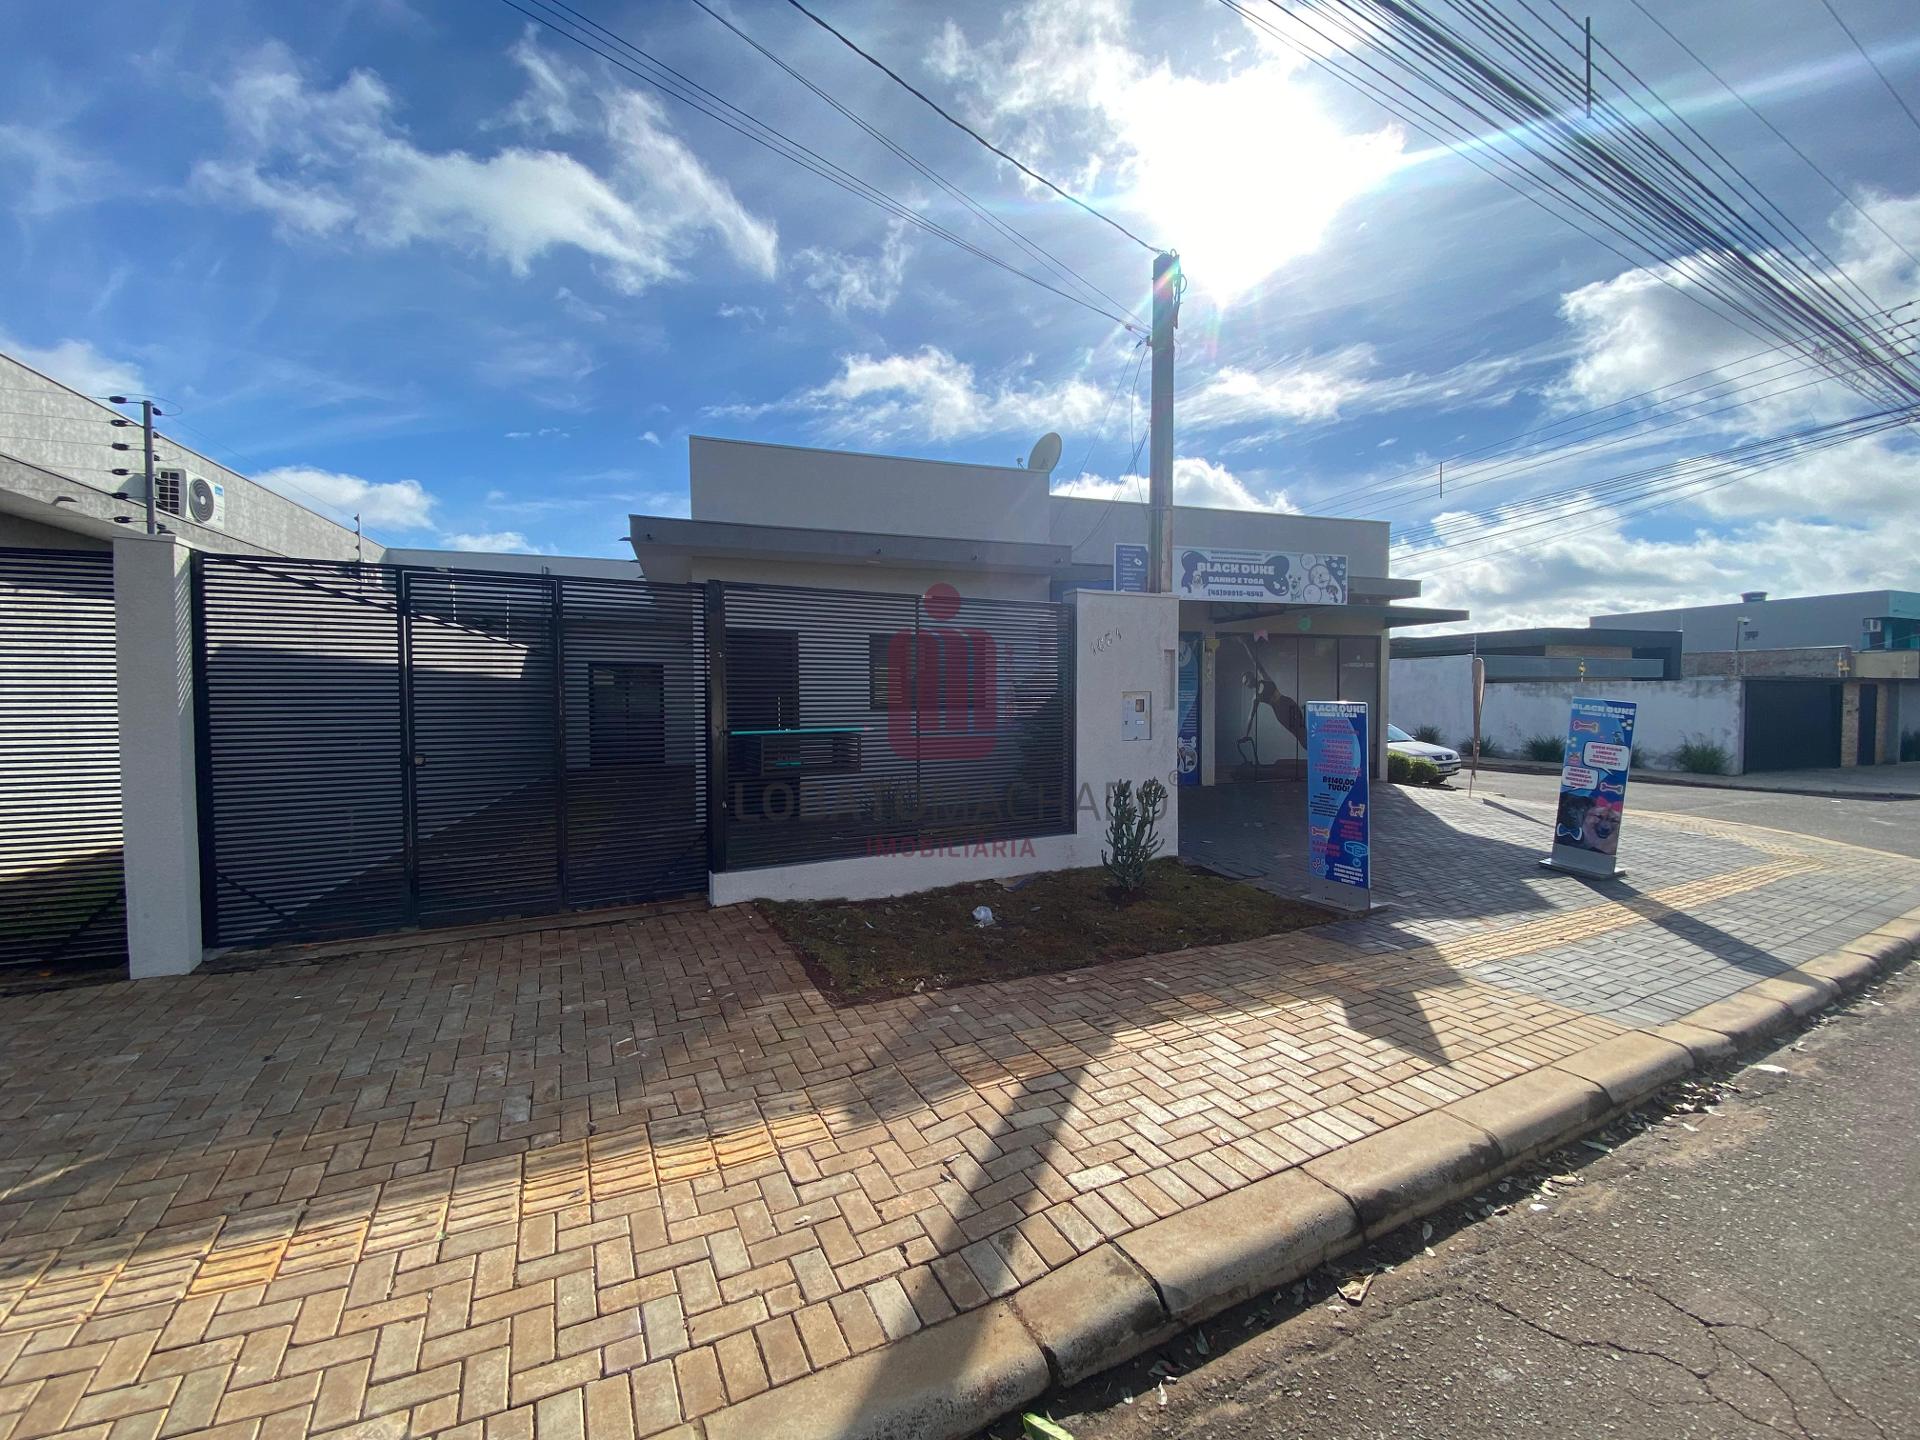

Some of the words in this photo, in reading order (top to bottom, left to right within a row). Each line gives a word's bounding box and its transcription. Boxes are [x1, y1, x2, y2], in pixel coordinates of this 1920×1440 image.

[1196, 562, 1239, 573] BLACK
[1241, 564, 1275, 576] DUKE
[1208, 576, 1236, 584] BANHO
[1308, 704, 1338, 713] BLACK
[1339, 705, 1366, 714] DUKE
[1572, 703, 1604, 711] BLACK
[1606, 707, 1635, 716] DUKE
